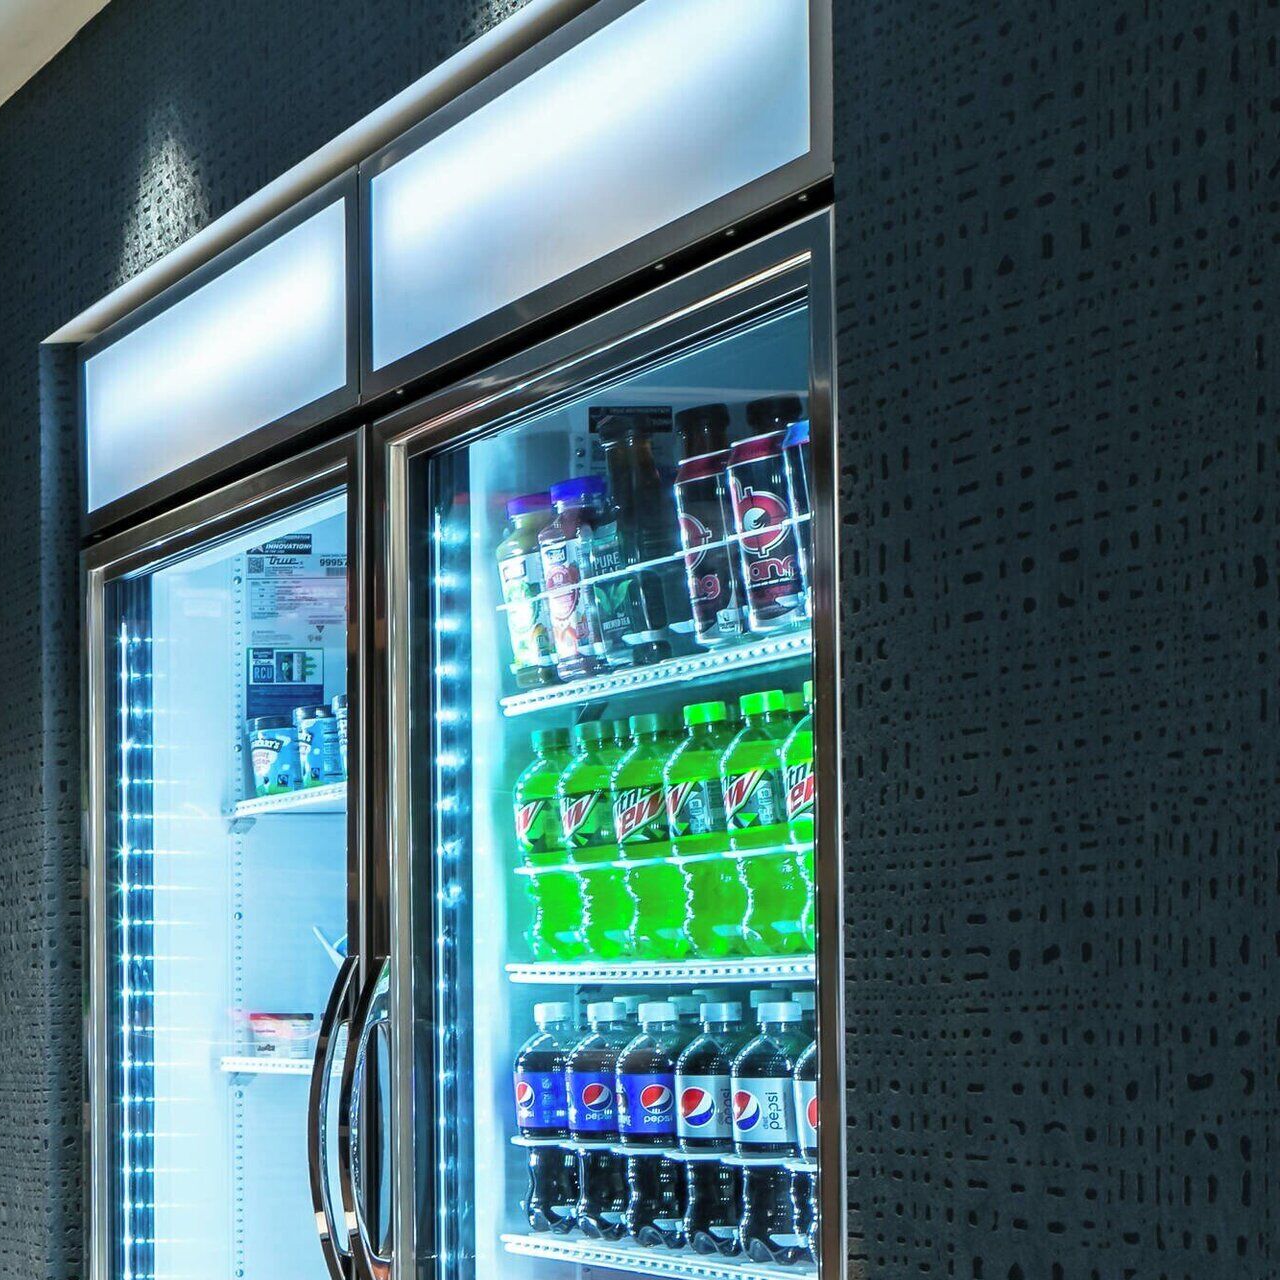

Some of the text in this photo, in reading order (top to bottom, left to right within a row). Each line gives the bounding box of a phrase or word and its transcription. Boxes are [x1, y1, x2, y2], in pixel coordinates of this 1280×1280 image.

[594, 551, 620, 570] PURE
[254, 665, 273, 680] RCU
[644, 1114, 673, 1124] pepsi
[765, 1091, 783, 1130] pepsi
